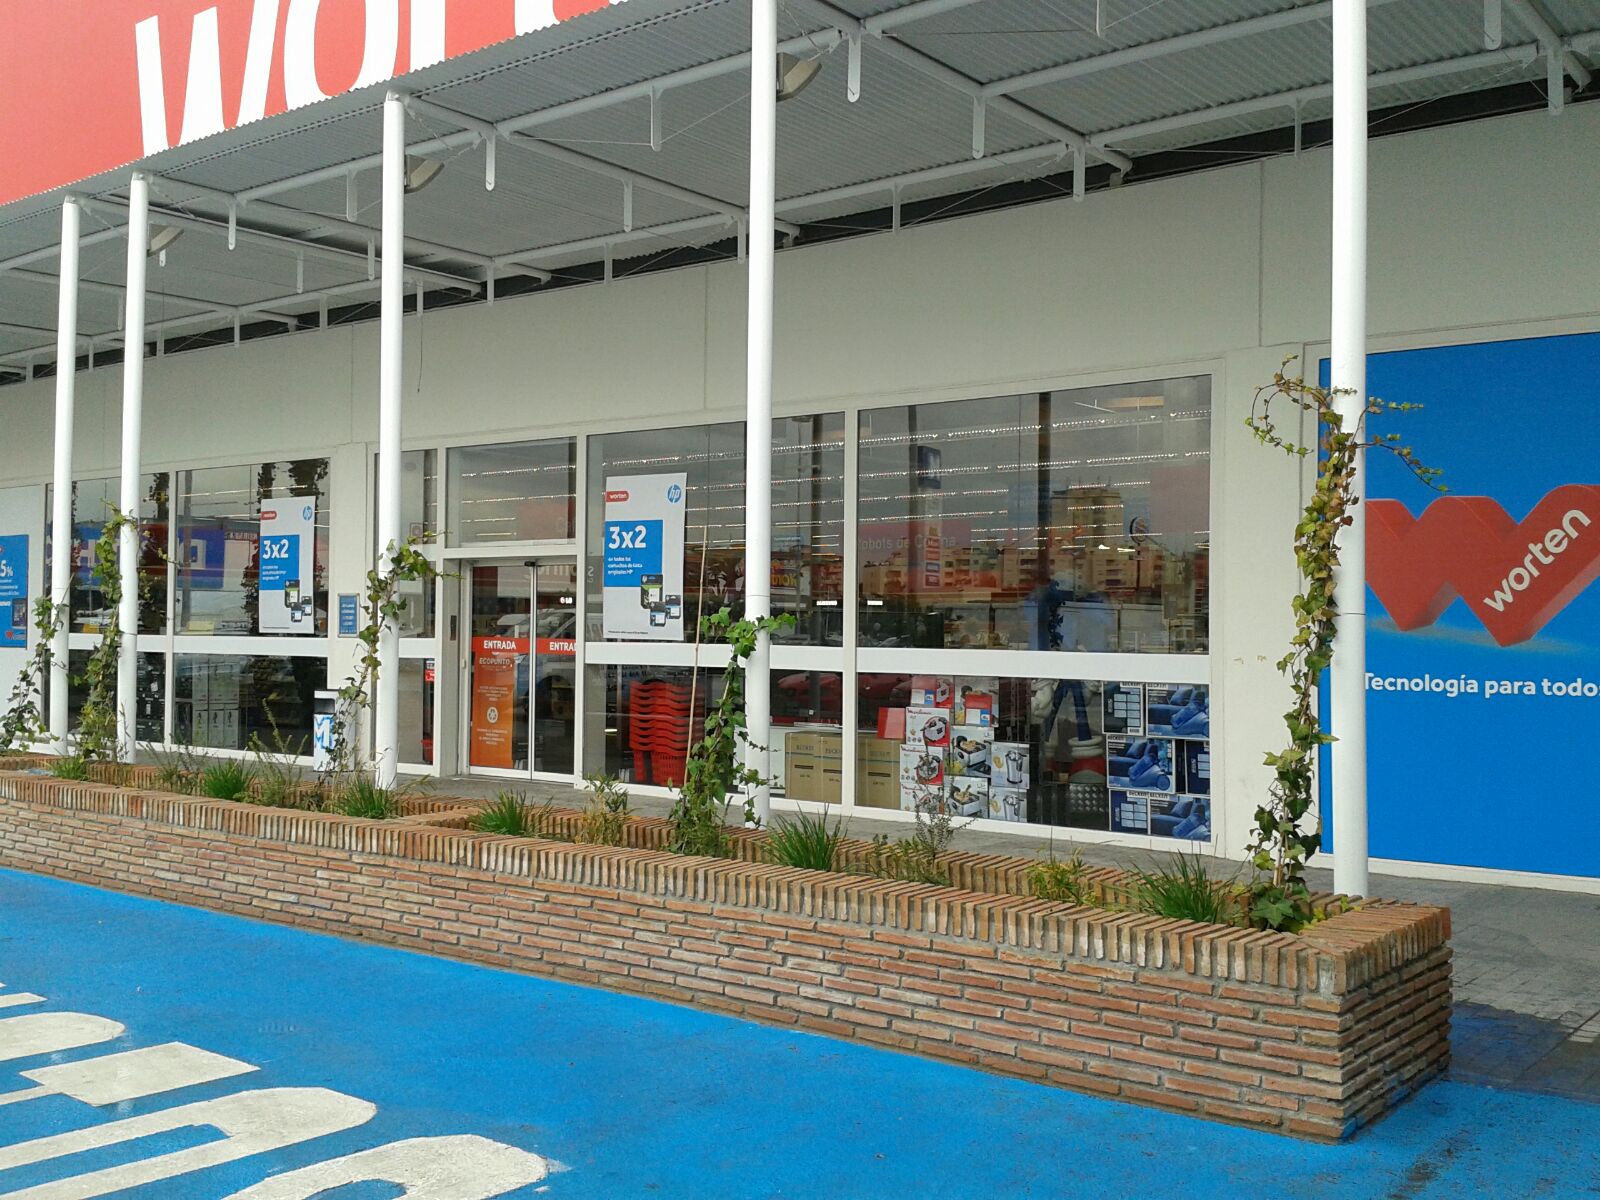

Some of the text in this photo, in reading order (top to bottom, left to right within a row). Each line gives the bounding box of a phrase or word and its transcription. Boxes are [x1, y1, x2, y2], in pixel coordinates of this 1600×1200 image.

[608, 525, 647, 549] 3x2
[262, 539, 289, 559] 3x2
[1483, 509, 1592, 612] worten
[483, 640, 517, 650] ENTRADA
[549, 641, 576, 651] ENTRA
[1365, 672, 1479, 698] Tecnología
[1485, 679, 1536, 698] para
